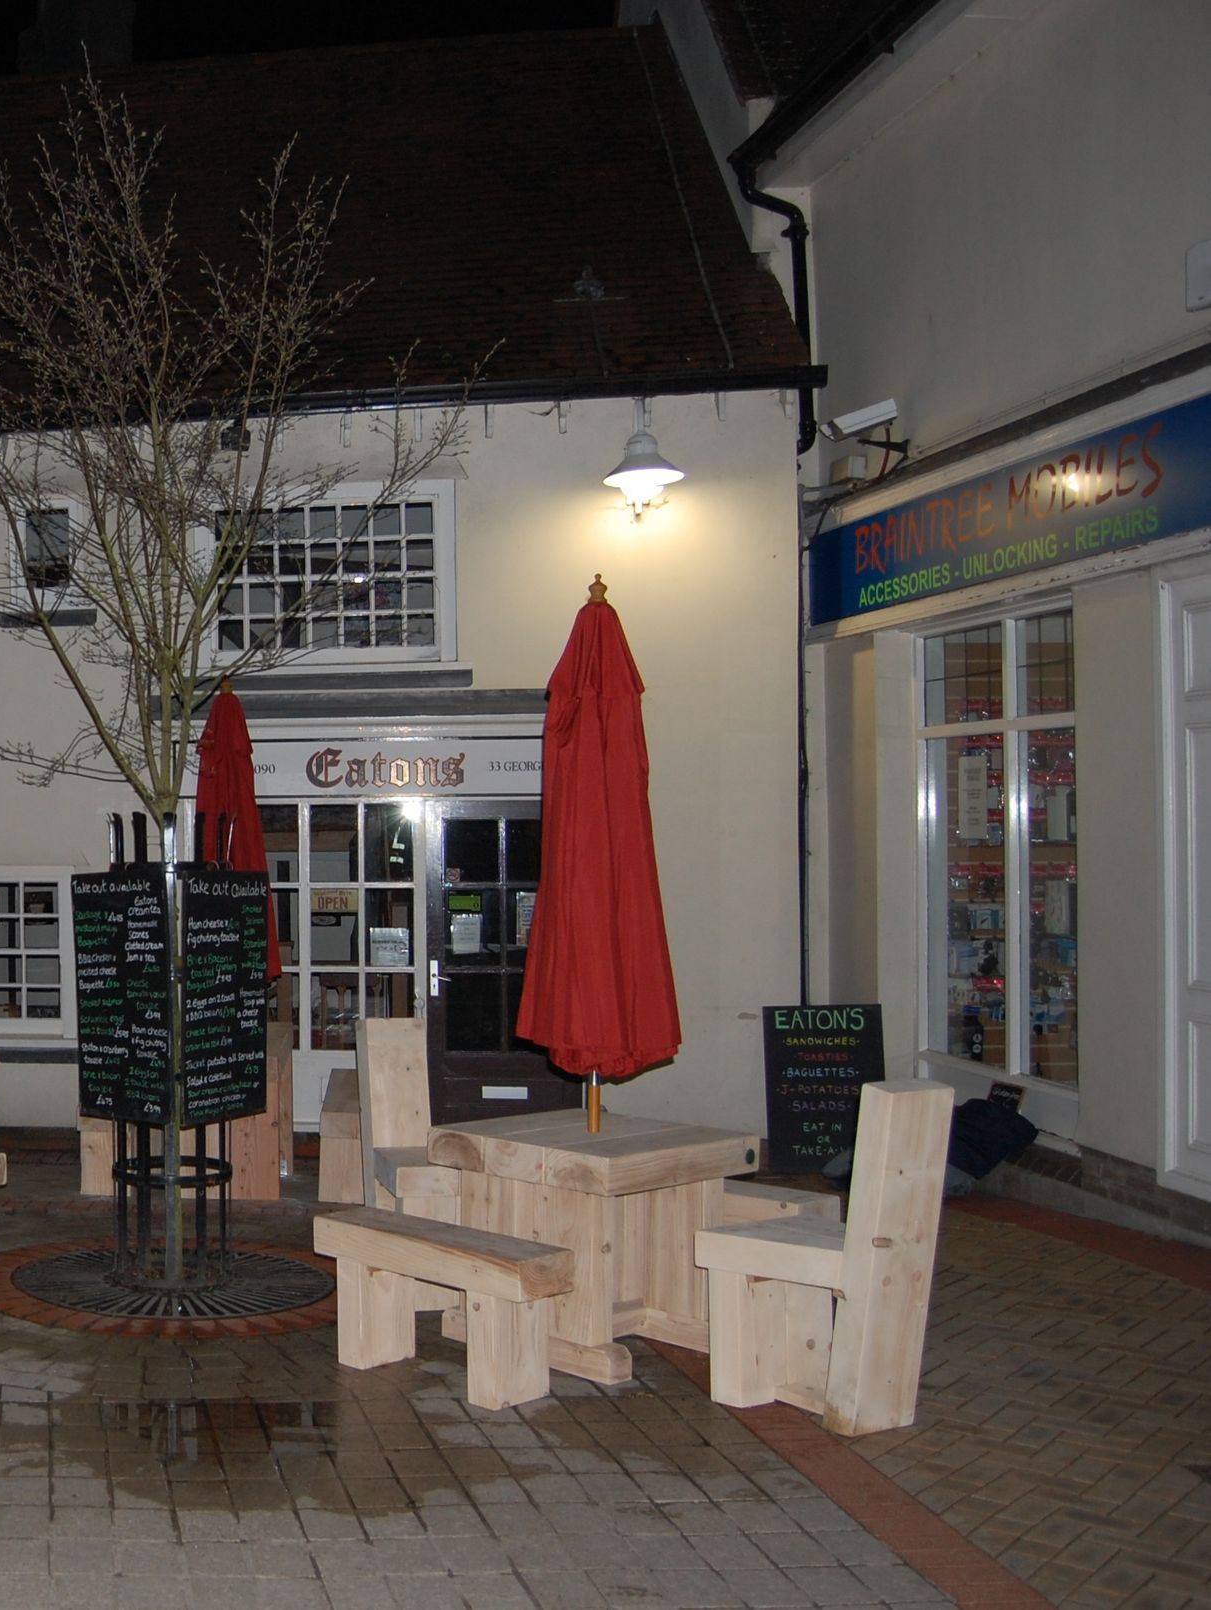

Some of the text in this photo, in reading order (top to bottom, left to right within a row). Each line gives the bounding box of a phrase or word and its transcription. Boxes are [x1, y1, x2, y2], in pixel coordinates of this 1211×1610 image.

[855, 421, 1165, 574] BRAINTREE MOBILES
[859, 505, 1159, 608] ACCESSORIES UNLOCKING REPAIRS
[306, 747, 466, 788] Eatons
[488, 760, 501, 772] 33
[72, 880, 91, 895] Take
[92, 880, 108, 894] out
[189, 877, 210, 895] Take
[213, 880, 229, 896] out
[317, 896, 348, 910] OPEN
[774, 1008, 865, 1032] EATON'S
[785, 1036, 856, 1047] SANDWICHES
[797, 1051, 849, 1062] TOASTIES
[786, 1066, 856, 1078] BAGUETTES
[792, 1100, 846, 1112] SALADS
[802, 1121, 842, 1133] EAT IN
[817, 1135, 831, 1144] OR
